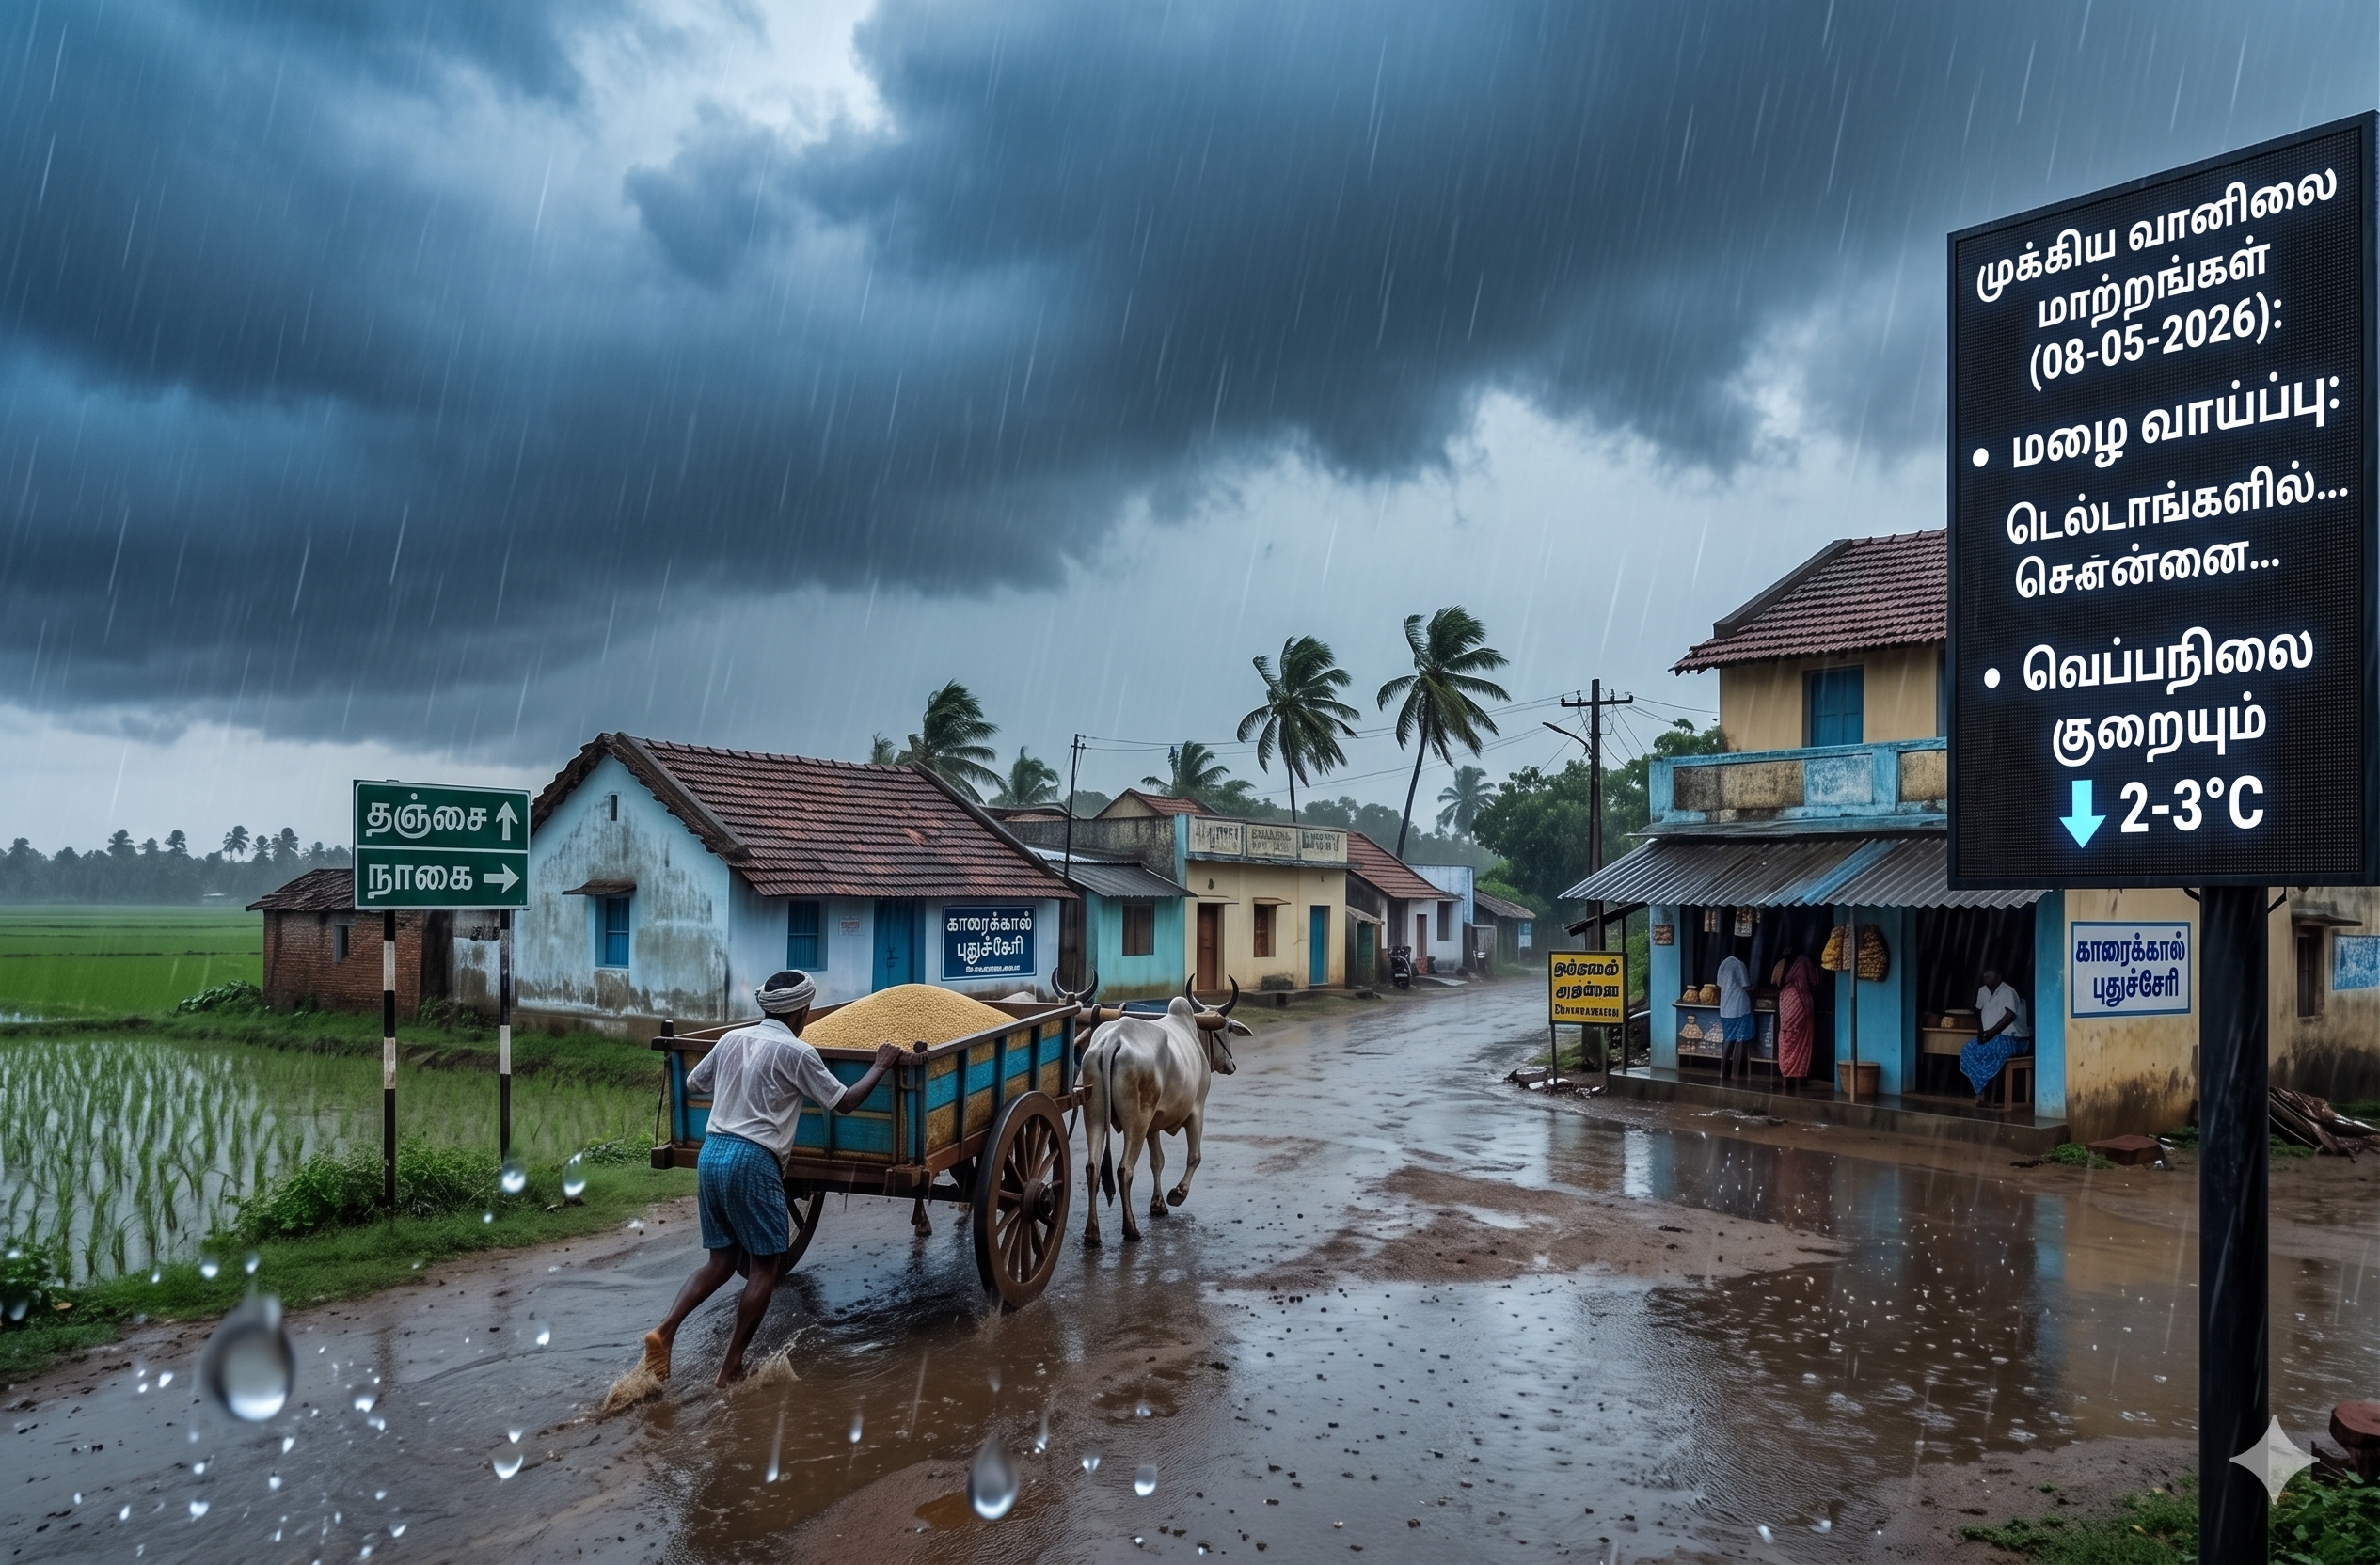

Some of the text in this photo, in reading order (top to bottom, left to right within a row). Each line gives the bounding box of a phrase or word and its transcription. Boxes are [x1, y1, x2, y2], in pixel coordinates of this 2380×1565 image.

[1976, 167, 2338, 303] முக்கிய வானிலை
[2038, 234, 2271, 329] மாற்றங்கள்
[2030, 291, 2282, 392] (08-05-2026):
[2013, 371, 2340, 468] மழை வாய்ப்பு:
[2023, 626, 2313, 695] வெப்பநிலை
[2053, 690, 2267, 767] குறையும்
[365, 792, 487, 839] தஞ்சை
[2119, 774, 2264, 833] 2-3°C
[367, 863, 473, 899] நாகை
[2075, 930, 2186, 968] காரைக்கால்
[2093, 966, 2179, 1008] புதுச்சேரி
